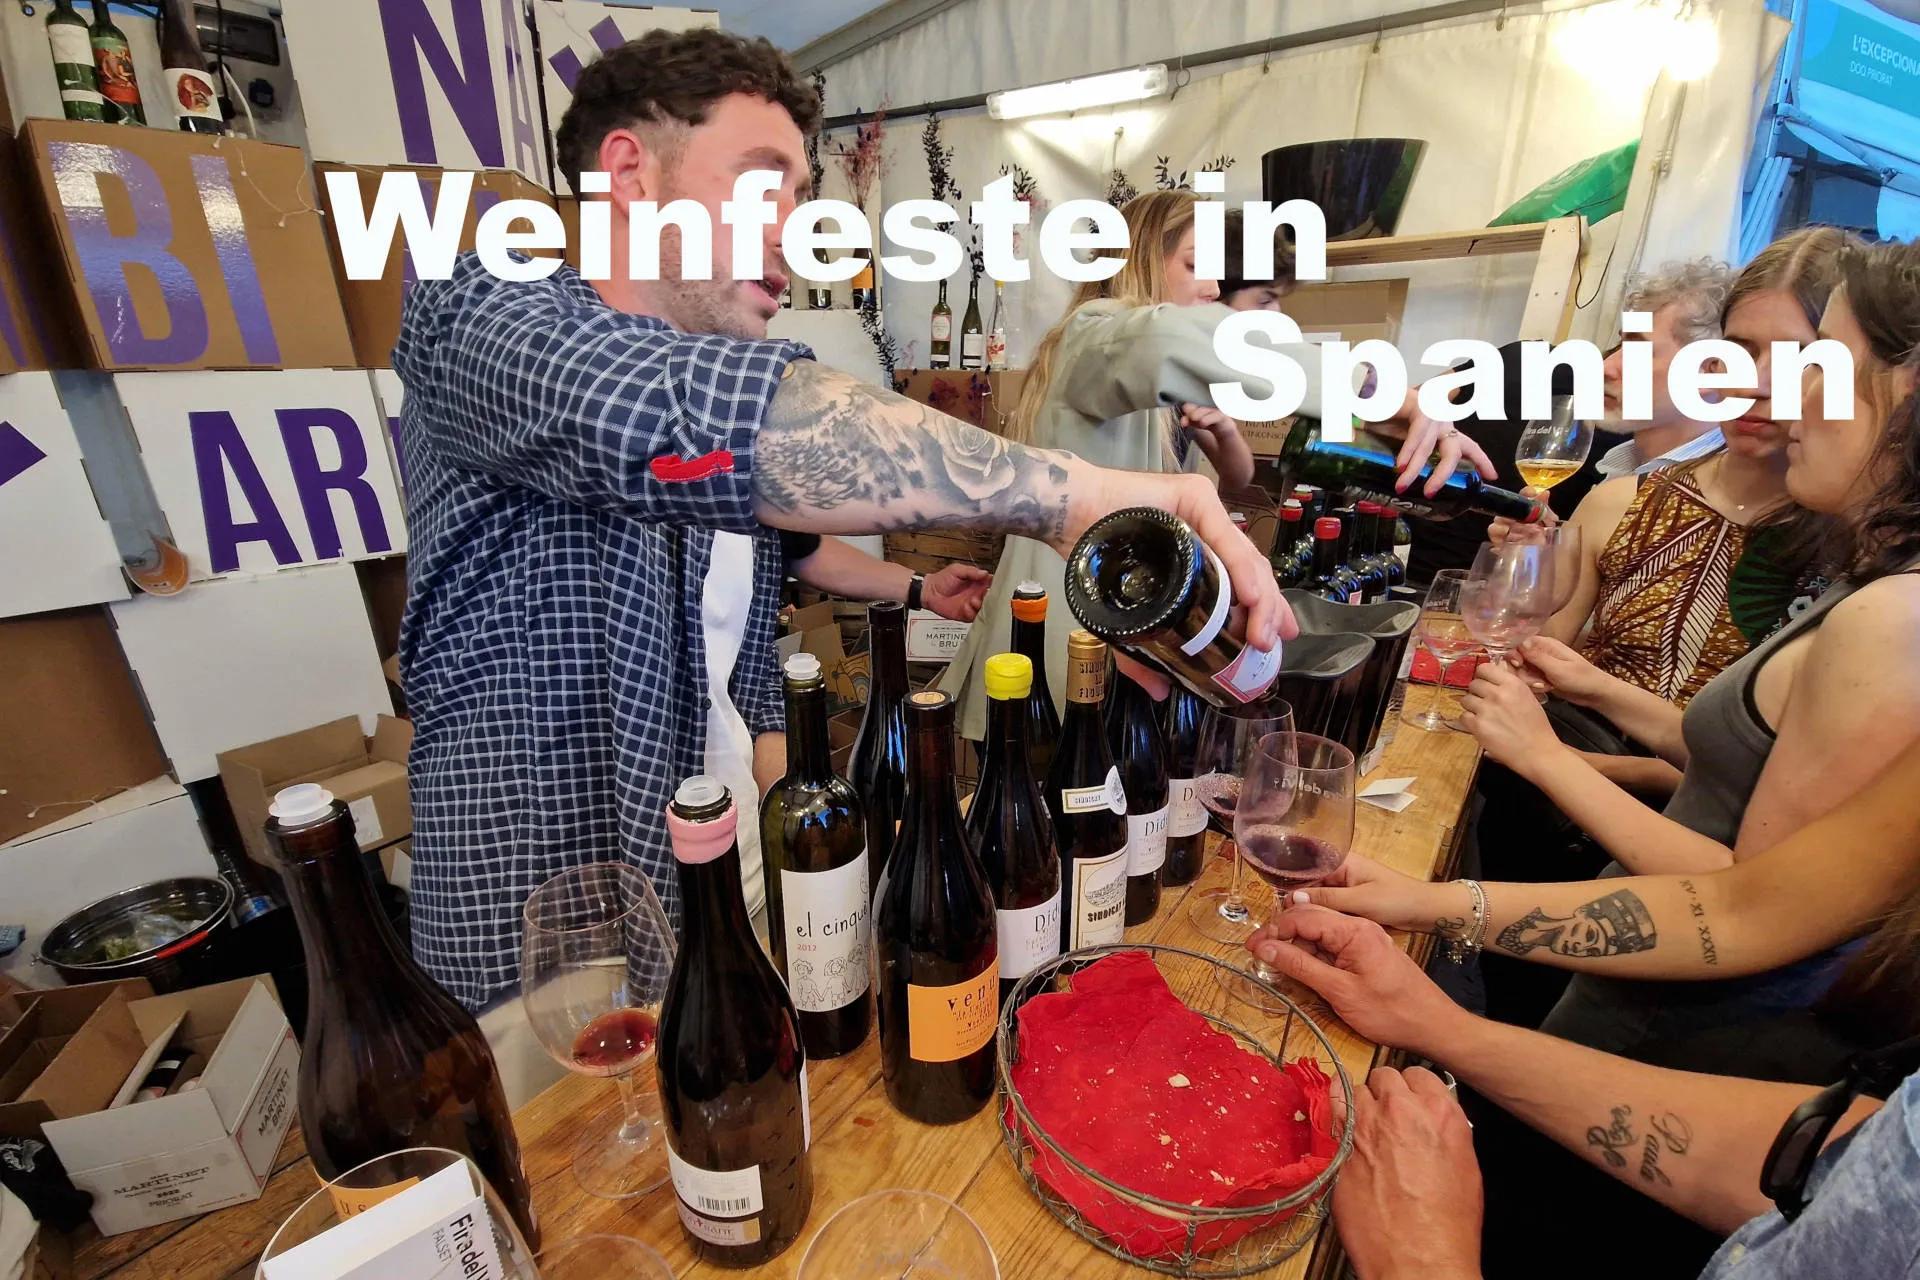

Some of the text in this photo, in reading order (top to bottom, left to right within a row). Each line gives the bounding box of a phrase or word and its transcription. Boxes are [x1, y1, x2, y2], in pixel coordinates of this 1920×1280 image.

[796, 911, 812, 938] el
[1035, 903, 1060, 933] Did
[797, 943, 817, 952] 2012
